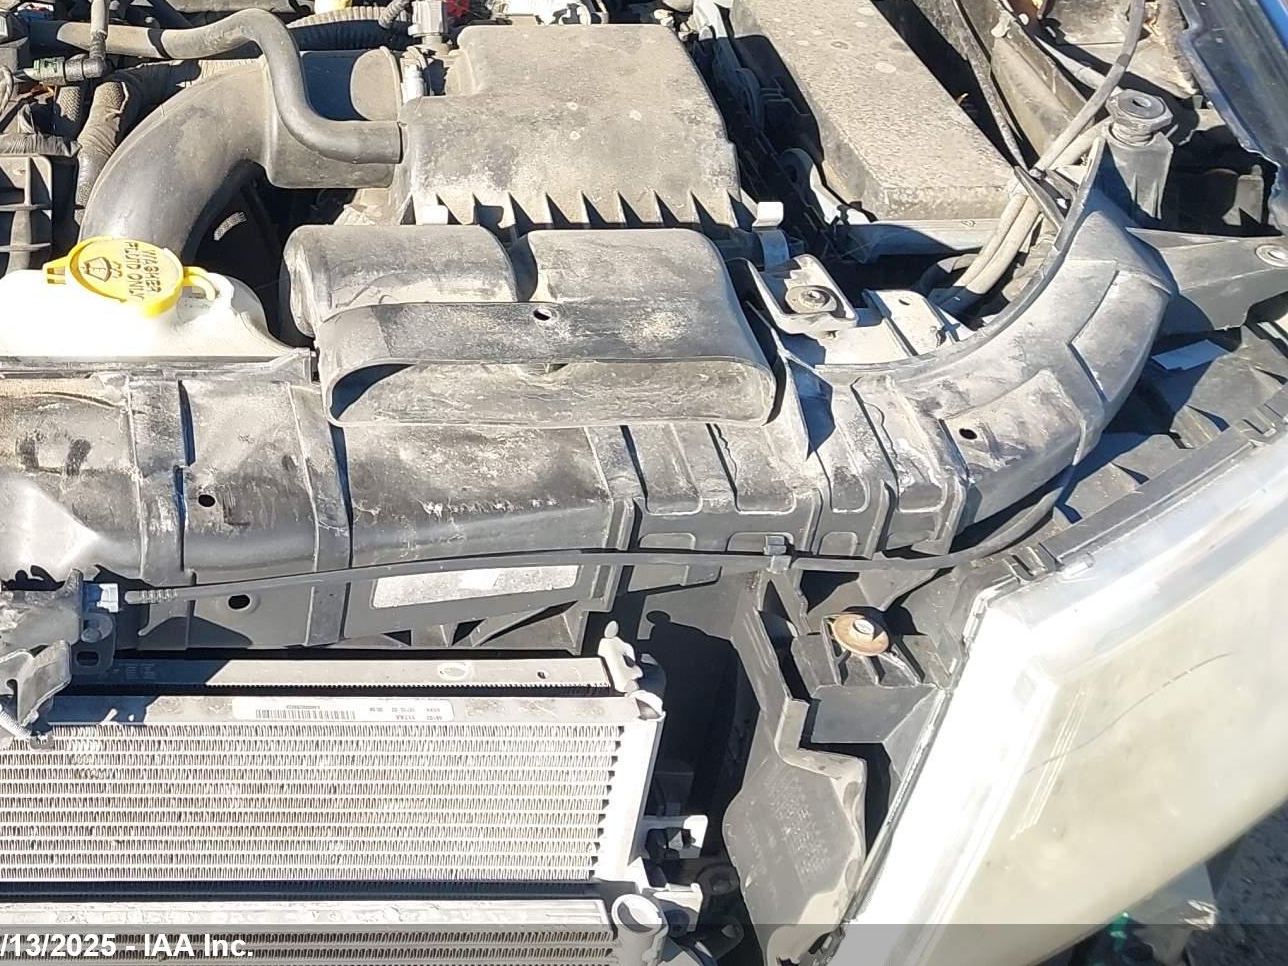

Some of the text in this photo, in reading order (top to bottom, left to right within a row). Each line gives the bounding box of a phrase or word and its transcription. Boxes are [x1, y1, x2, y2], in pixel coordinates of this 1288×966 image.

[124, 240, 145, 303] FLUID ONLY
[141, 247, 162, 294] WASHER
